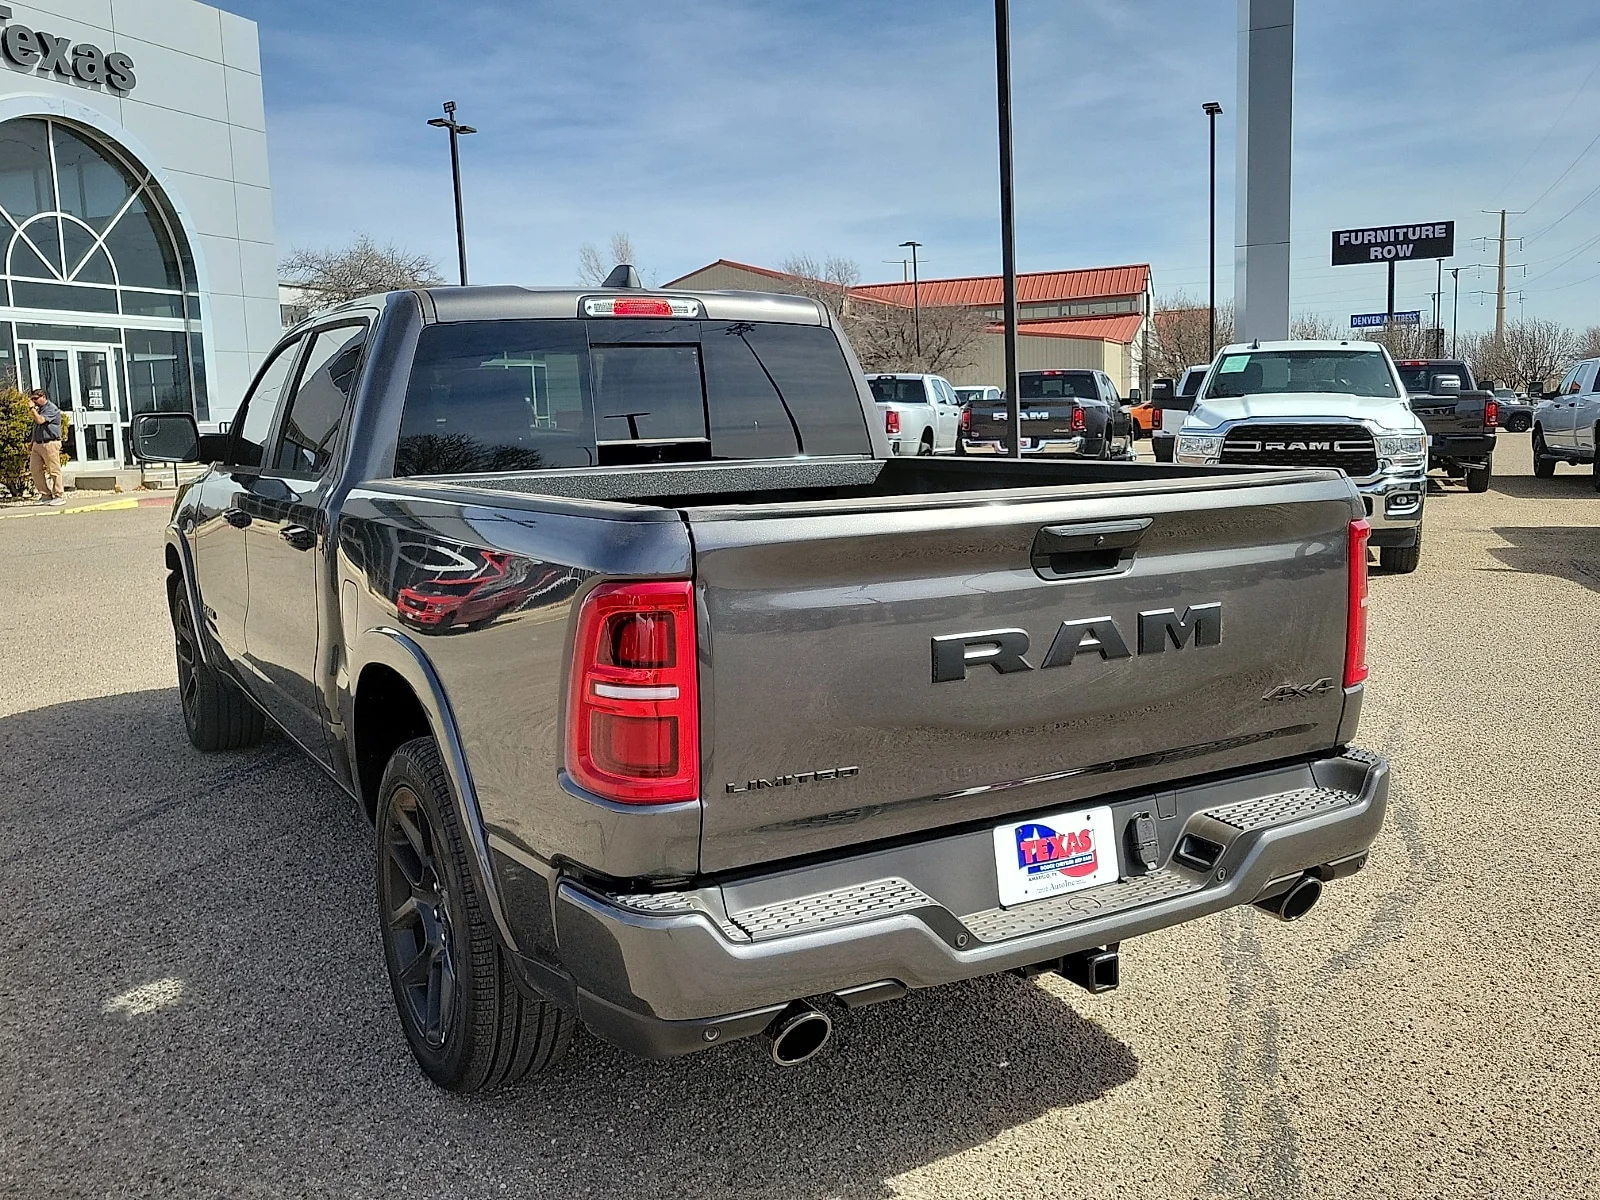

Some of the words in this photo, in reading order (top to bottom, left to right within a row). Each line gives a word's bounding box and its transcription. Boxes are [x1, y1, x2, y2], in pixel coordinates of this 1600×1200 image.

[1339, 224, 1447, 246] FURNITURE
[1369, 243, 1414, 260] ROW
[1352, 315, 1381, 326] DENVER
[1383, 313, 1417, 324] MTTRESS
[1265, 442, 1330, 451] RAM
[930, 601, 1222, 684] RAM
[725, 765, 859, 793] LIMITED
[1020, 829, 1092, 864] TEXAS
